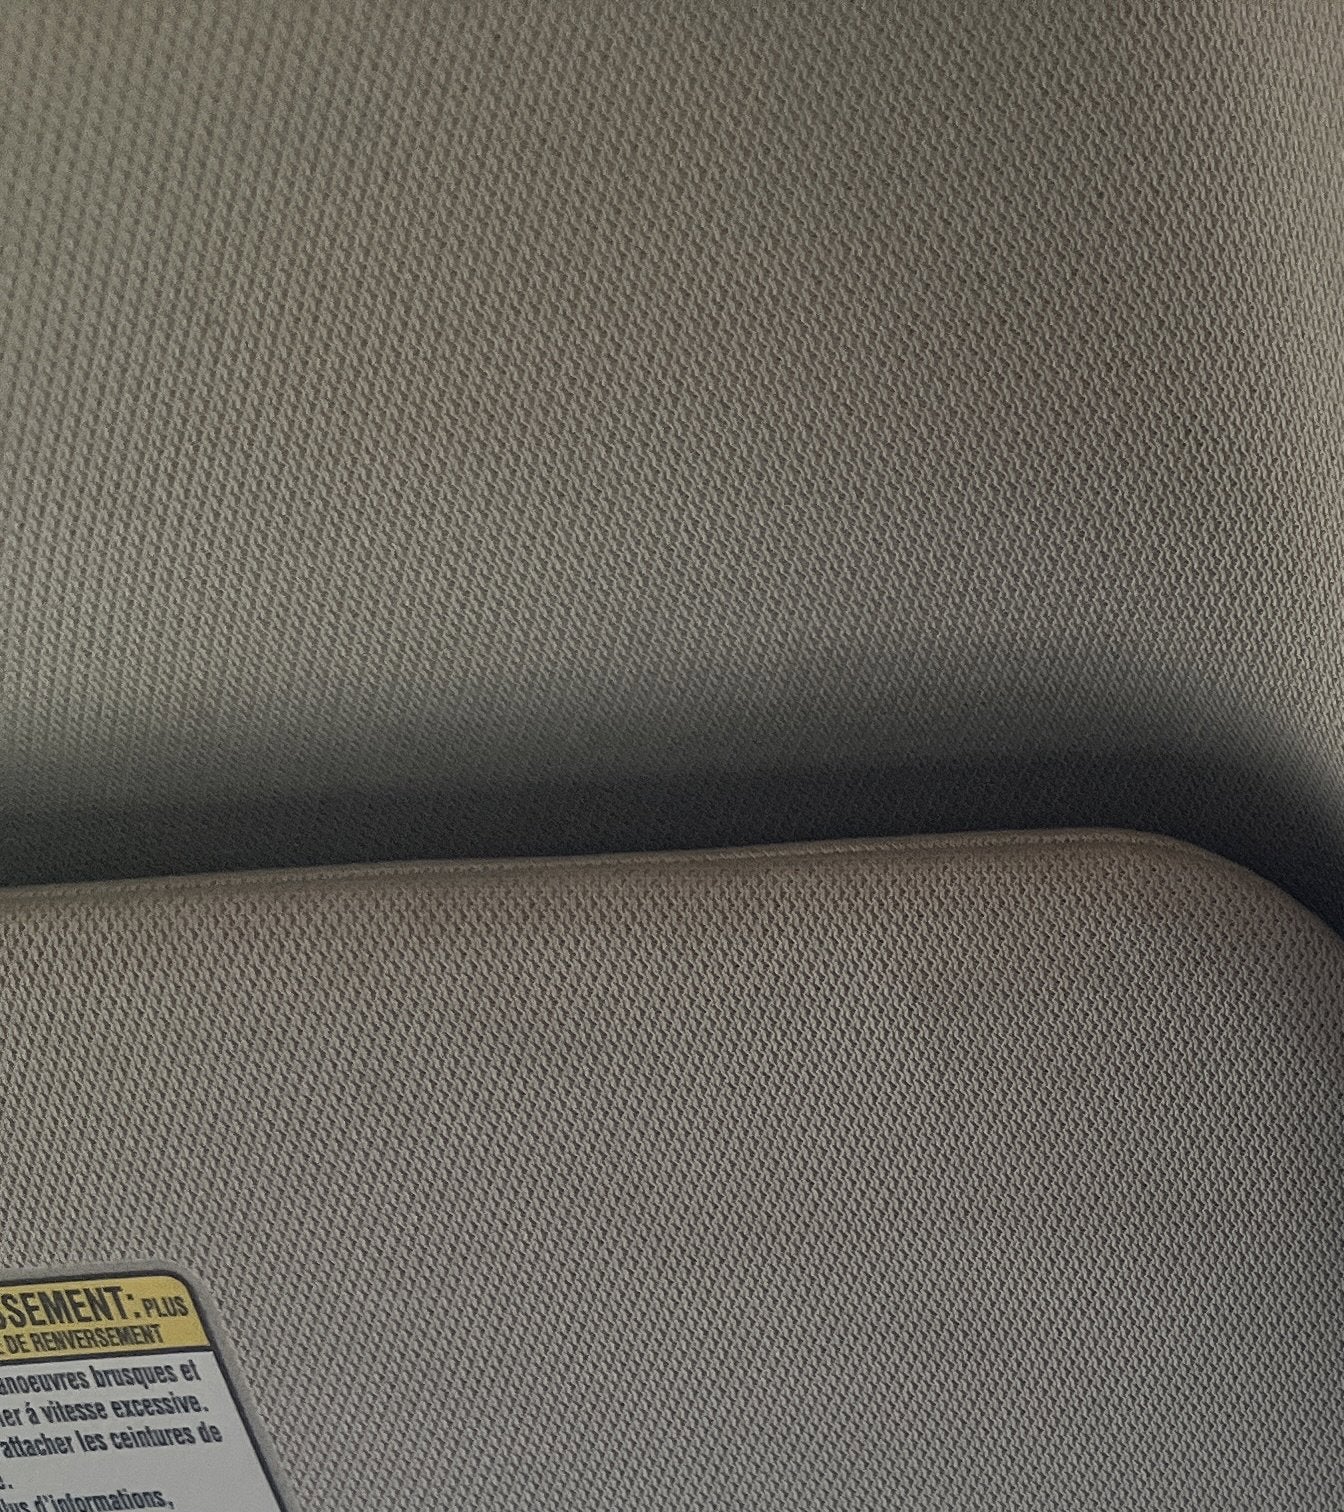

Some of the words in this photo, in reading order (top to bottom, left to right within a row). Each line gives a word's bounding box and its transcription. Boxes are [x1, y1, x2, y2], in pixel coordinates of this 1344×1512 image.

[0, 1286, 141, 1330] SEMENT:
[142, 1296, 189, 1318] PLUS
[4, 1333, 31, 1355] DE
[30, 1323, 164, 1352] RENVERSEMENT
[89, 1364, 178, 1390] brusques
[180, 1359, 202, 1382] et
[41, 1400, 108, 1424] vitesse
[111, 1391, 209, 1419] excessive.
[75, 1429, 108, 1453] les
[110, 1425, 196, 1450] ceintures
[199, 1421, 223, 1443] de
